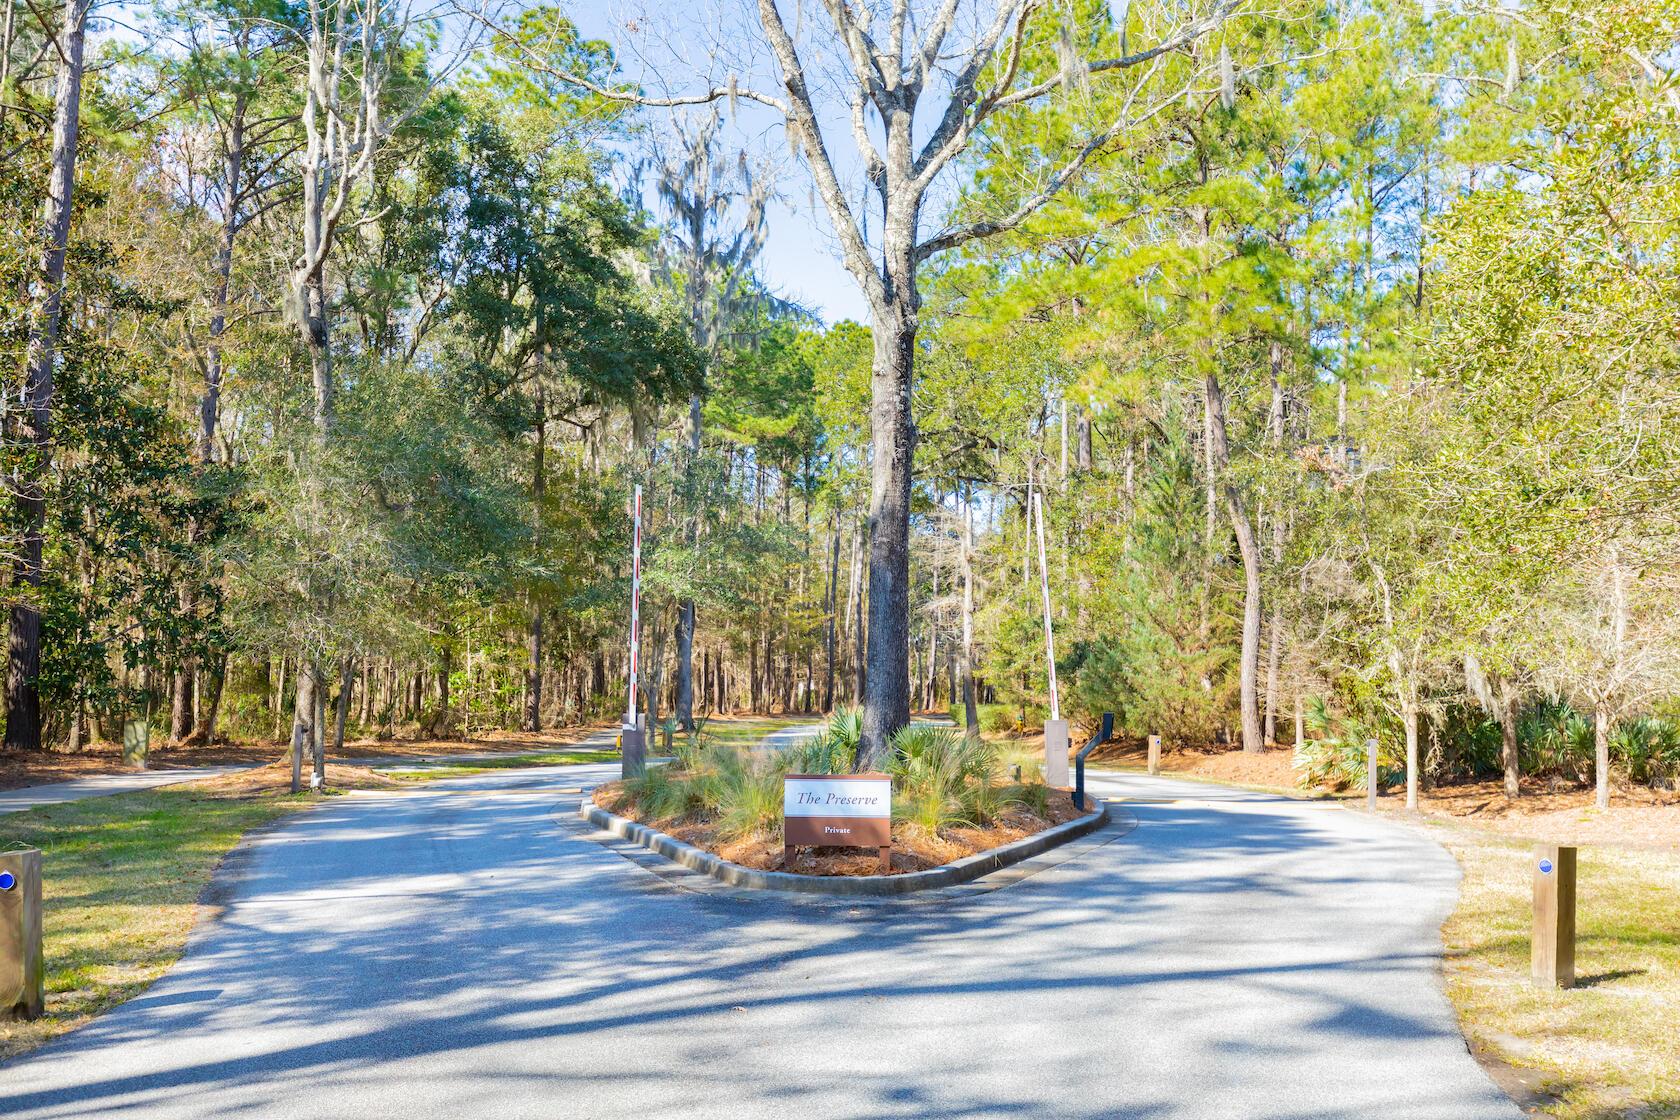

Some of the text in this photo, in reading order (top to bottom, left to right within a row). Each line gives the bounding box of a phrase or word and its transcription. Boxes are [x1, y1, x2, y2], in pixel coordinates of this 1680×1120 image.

[798, 792, 878, 804] The Preserve
[824, 826, 851, 834] Private
